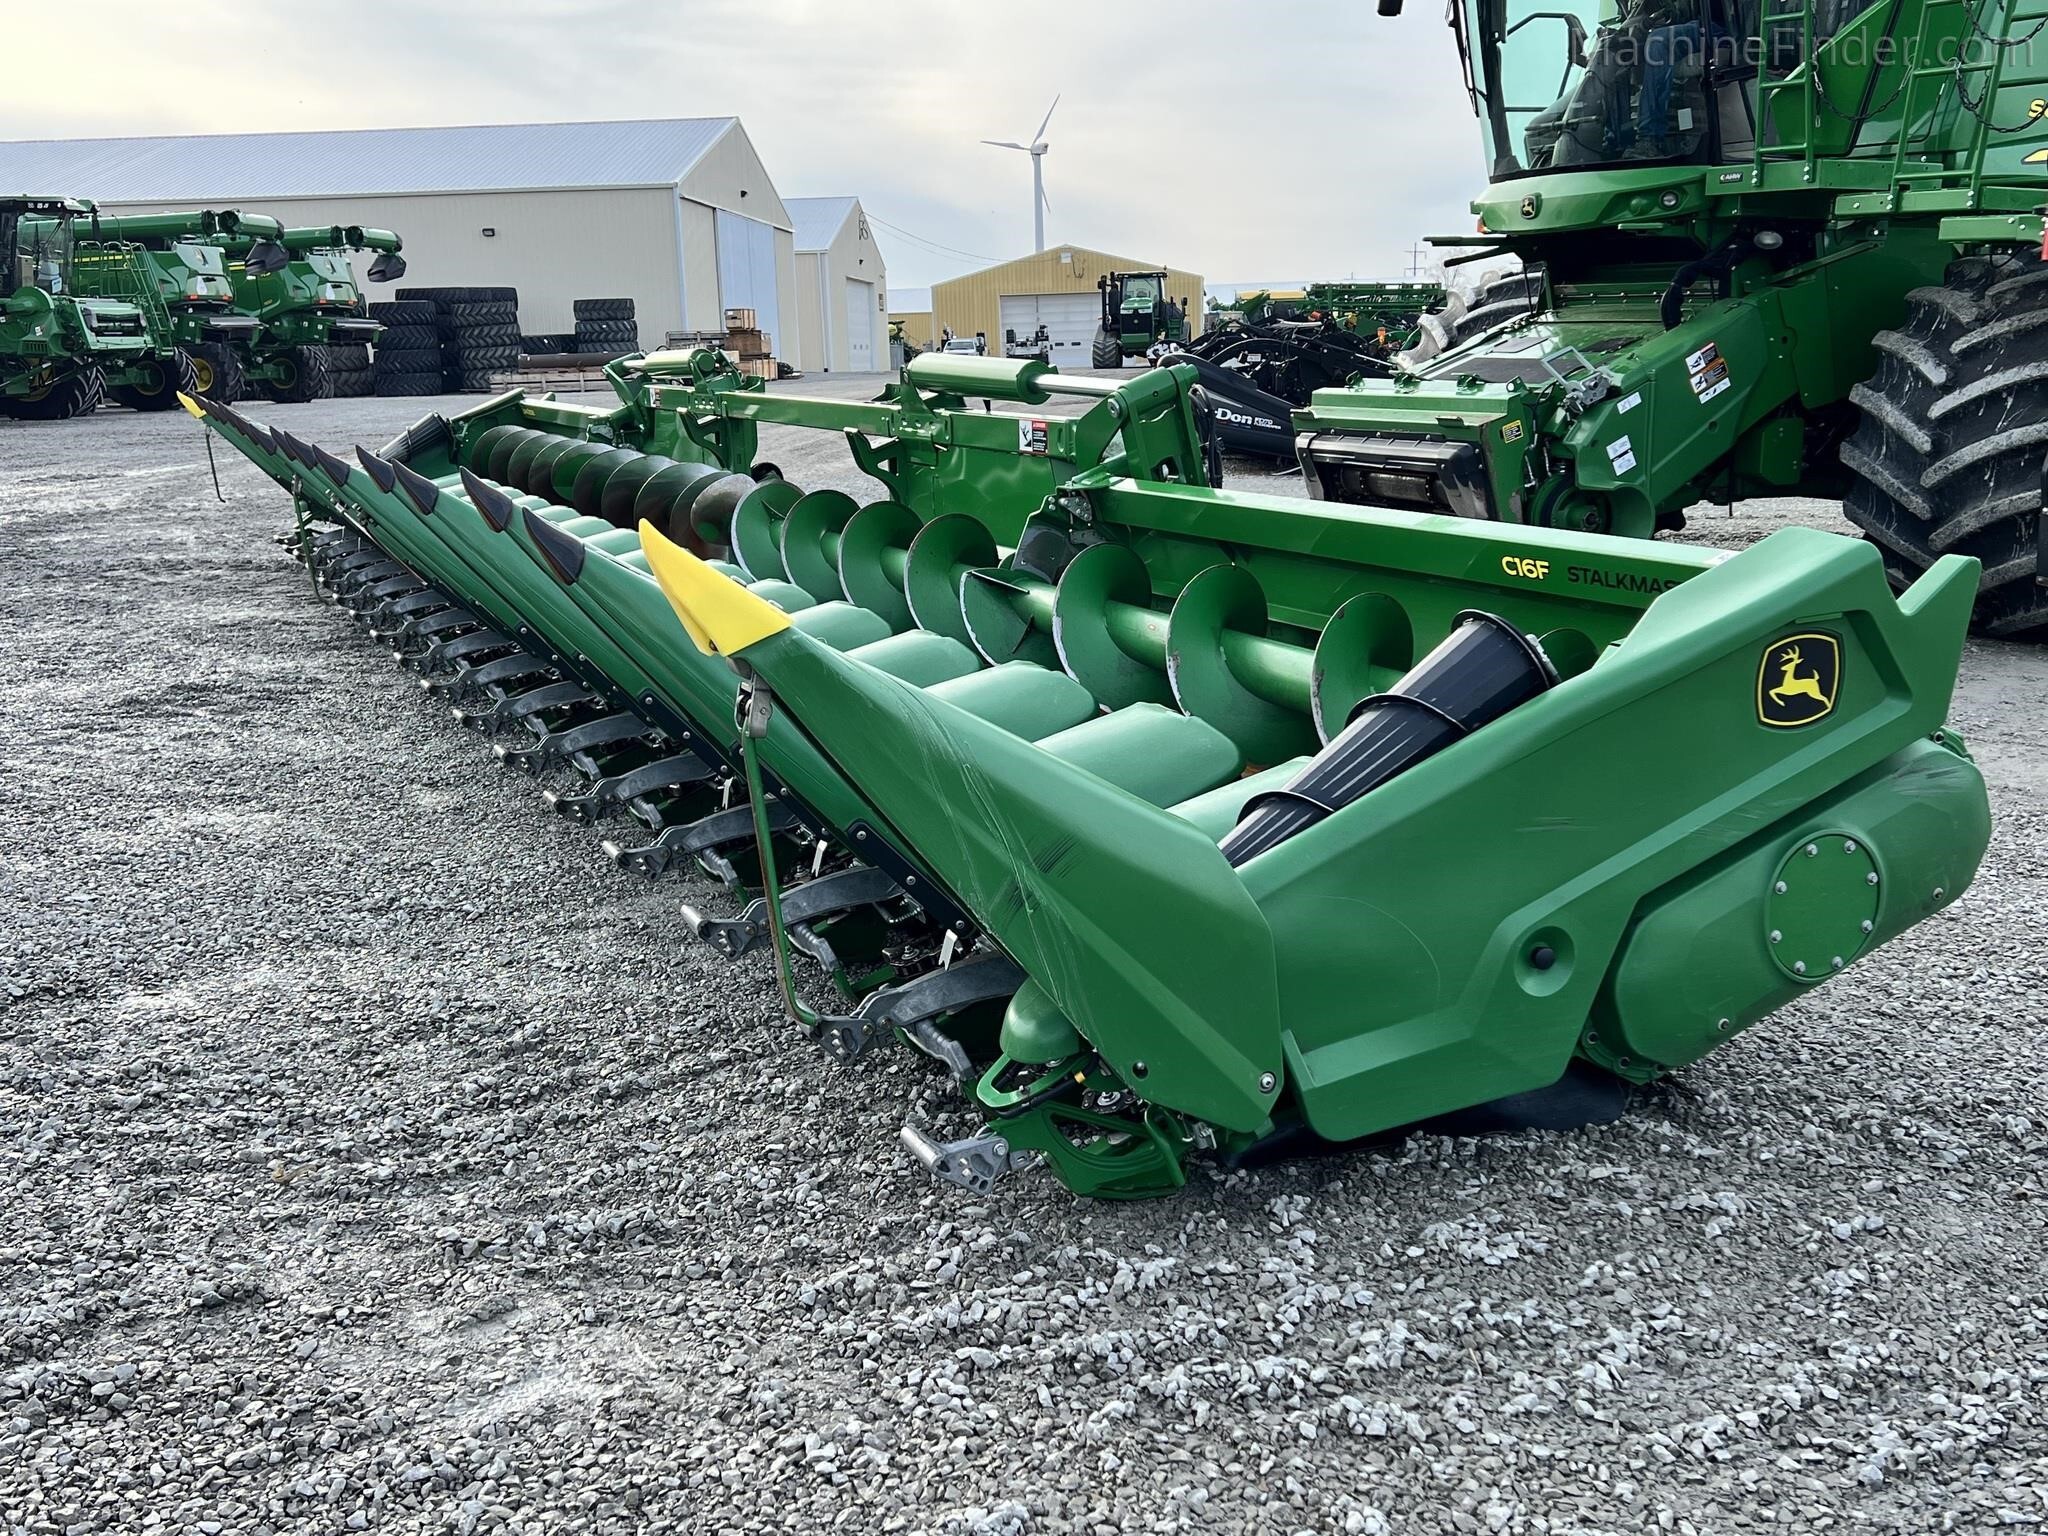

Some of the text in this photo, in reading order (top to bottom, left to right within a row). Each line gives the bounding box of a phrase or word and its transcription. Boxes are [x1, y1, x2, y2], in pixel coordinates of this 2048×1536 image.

[1214, 407, 1253, 425] Don
[1501, 556, 1682, 594] C16F STALKMAS
